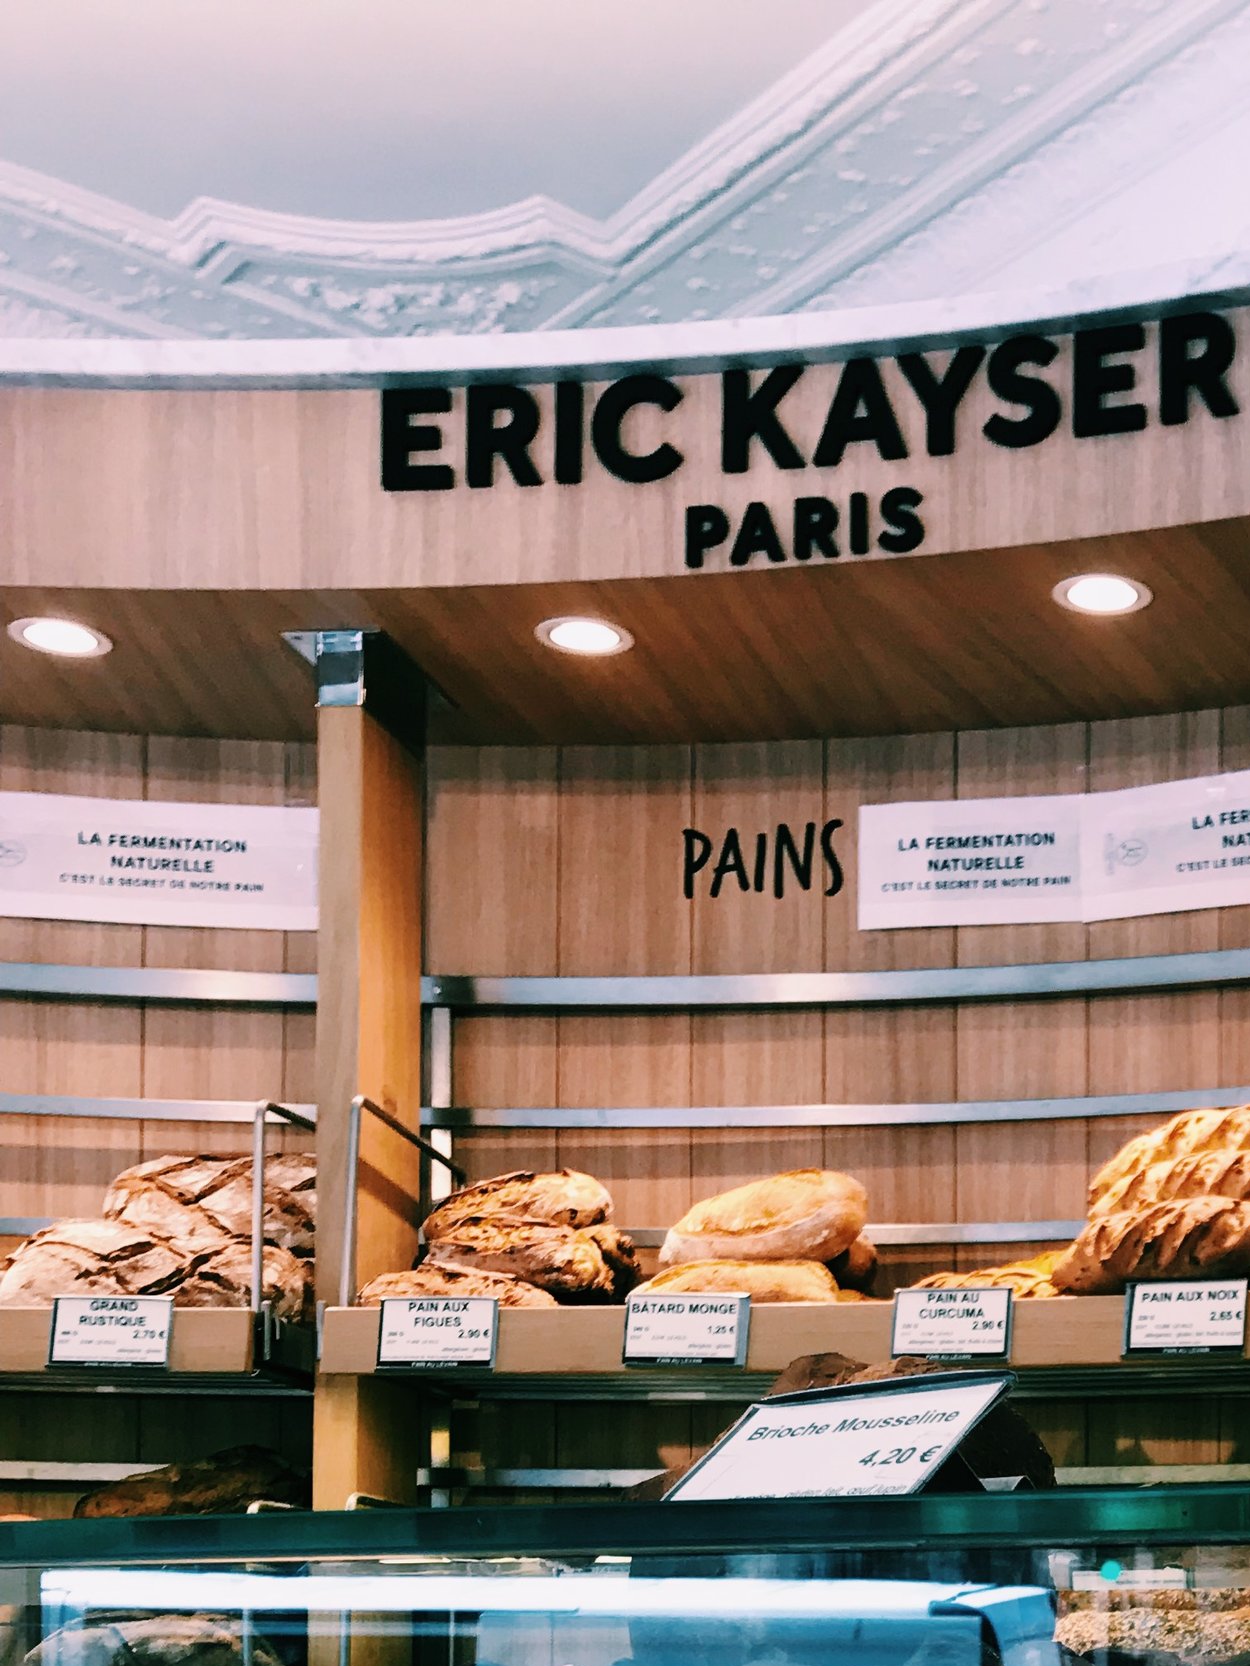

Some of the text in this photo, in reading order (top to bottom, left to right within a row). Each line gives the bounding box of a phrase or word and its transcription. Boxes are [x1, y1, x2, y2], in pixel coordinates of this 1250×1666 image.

[380, 310, 1240, 492] ERIC KAYSER
[684, 487, 925, 569] PARIS
[1191, 815, 1215, 830] LA
[77, 831, 249, 853] LA FERMENTATION
[898, 832, 1056, 852] LA FERMENTATION
[110, 855, 215, 873] NATURELLE
[682, 819, 844, 899] PAINS
[927, 856, 1025, 873] NATURELLE
[927, 1292, 980, 1304] PAIN AU
[1142, 1289, 1239, 1303] PAIN AUX NOIX
[89, 1300, 139, 1312] GRAND
[408, 1301, 470, 1313] PAIN AUX
[631, 1300, 738, 1315] BÂTARD MONGE
[919, 1307, 985, 1319] CURCUMA
[78, 1315, 147, 1327] RUSTIQUE
[413, 1316, 463, 1328] FIGUES
[747, 1409, 960, 1441] Brioche Mousseline
[858, 1445, 943, 1466] 4,20 €
